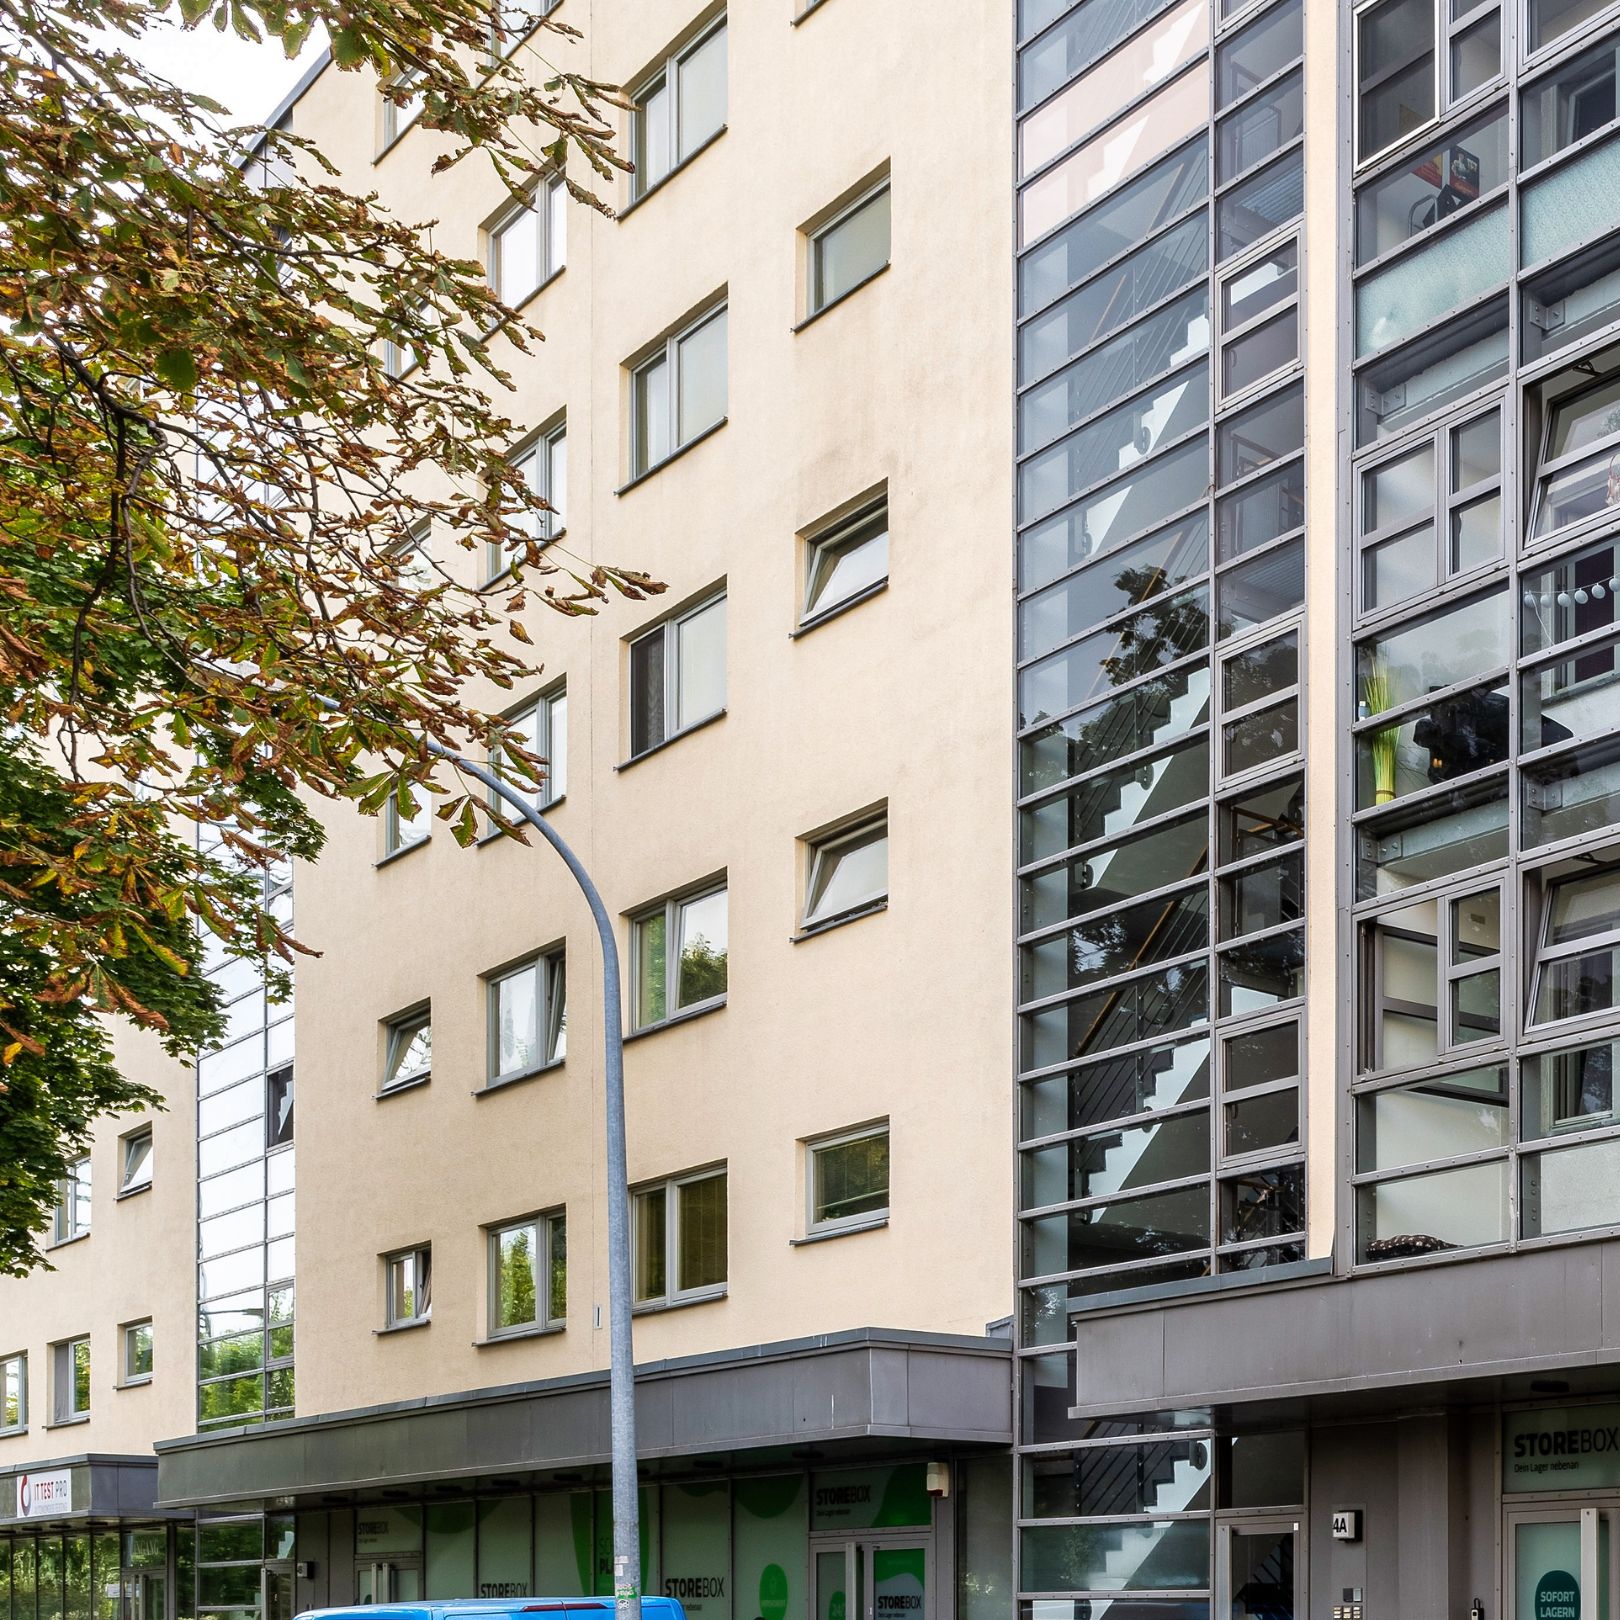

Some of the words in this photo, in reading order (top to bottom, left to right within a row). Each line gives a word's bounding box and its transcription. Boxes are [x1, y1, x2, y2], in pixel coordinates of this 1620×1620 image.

[1514, 1427, 1620, 1457] STOREBOX
[1514, 1463, 1530, 1474] Dein
[1530, 1461, 1549, 1474] Lager
[1550, 1460, 1580, 1472] nebenan
[40, 1481, 54, 1500] TEST
[55, 1479, 67, 1498] PRO
[816, 1484, 872, 1506] STOREBOX
[1332, 1517, 1347, 1533] 4A
[480, 1582, 528, 1598] STOREBOX
[665, 1576, 725, 1598] STOREBOX
[878, 1595, 922, 1609] STOREBOX
[1540, 1591, 1575, 1603] SOFORT
[1540, 1606, 1575, 1618] LAGERN
